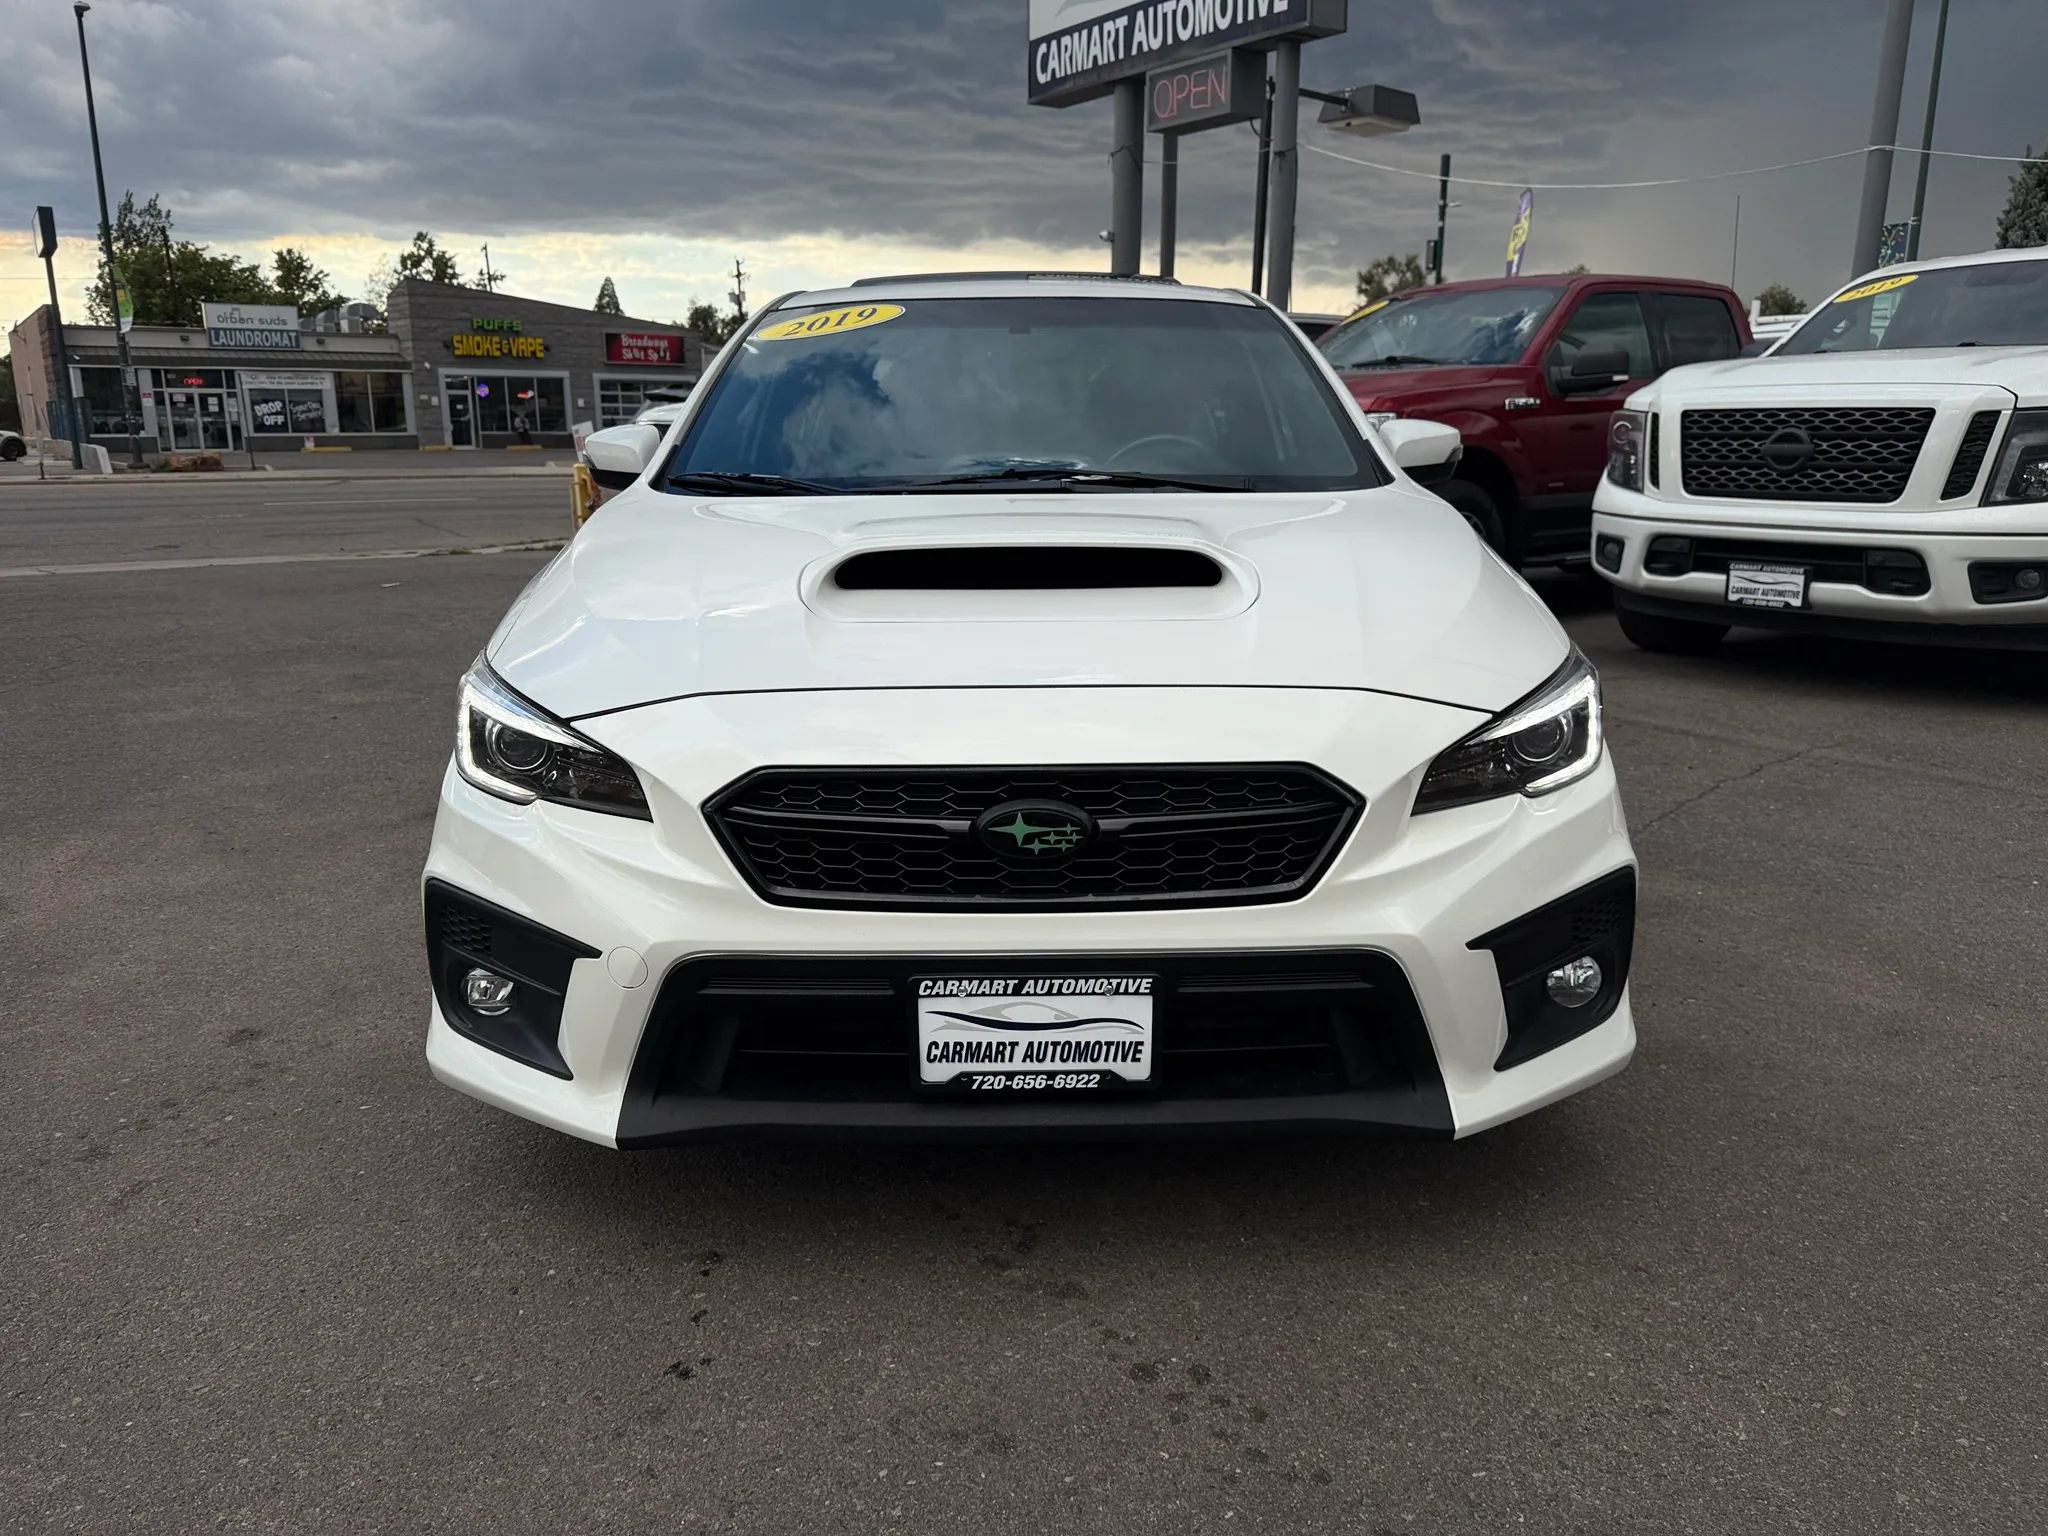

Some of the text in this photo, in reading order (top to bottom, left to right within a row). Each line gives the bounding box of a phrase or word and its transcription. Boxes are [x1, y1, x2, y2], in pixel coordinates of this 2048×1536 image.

[1035, 15, 1128, 84] CARMART
[1153, 67, 1228, 120] OPEN
[258, 317, 288, 326] suds
[472, 318, 522, 331] PUFFS
[781, 307, 878, 337] 2019
[210, 329, 297, 347] LAUNDROMAT
[453, 335, 501, 357] SMOKE
[509, 336, 545, 358] VAPE
[254, 401, 283, 416] DROP
[263, 415, 285, 426] OFF
[1731, 586, 1760, 596] CARMART
[918, 979, 1153, 996] CARMART AUTOMOTIVE
[926, 1040, 1145, 1063] CARMART AUTOMOTIVE
[971, 1074, 1101, 1090] 720-656-6922
